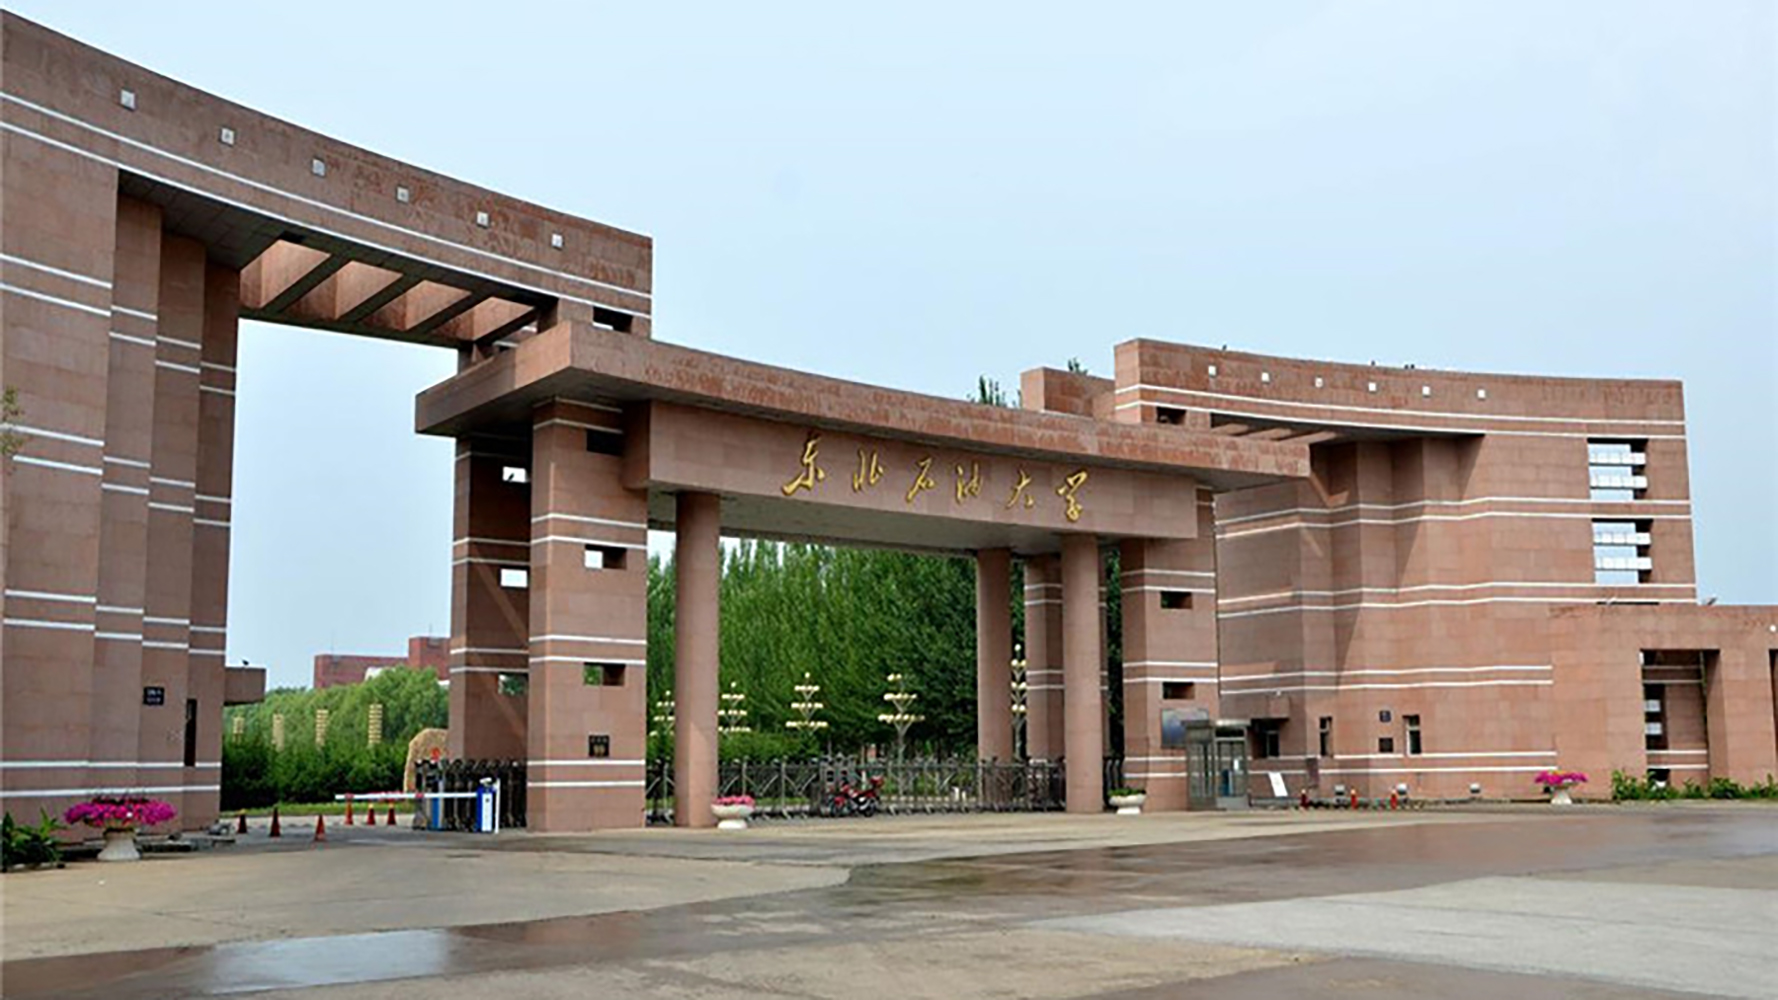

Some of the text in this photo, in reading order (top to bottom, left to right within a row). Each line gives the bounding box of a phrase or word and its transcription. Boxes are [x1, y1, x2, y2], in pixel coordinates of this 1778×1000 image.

[782, 436, 1088, 522] 东北石油大学
